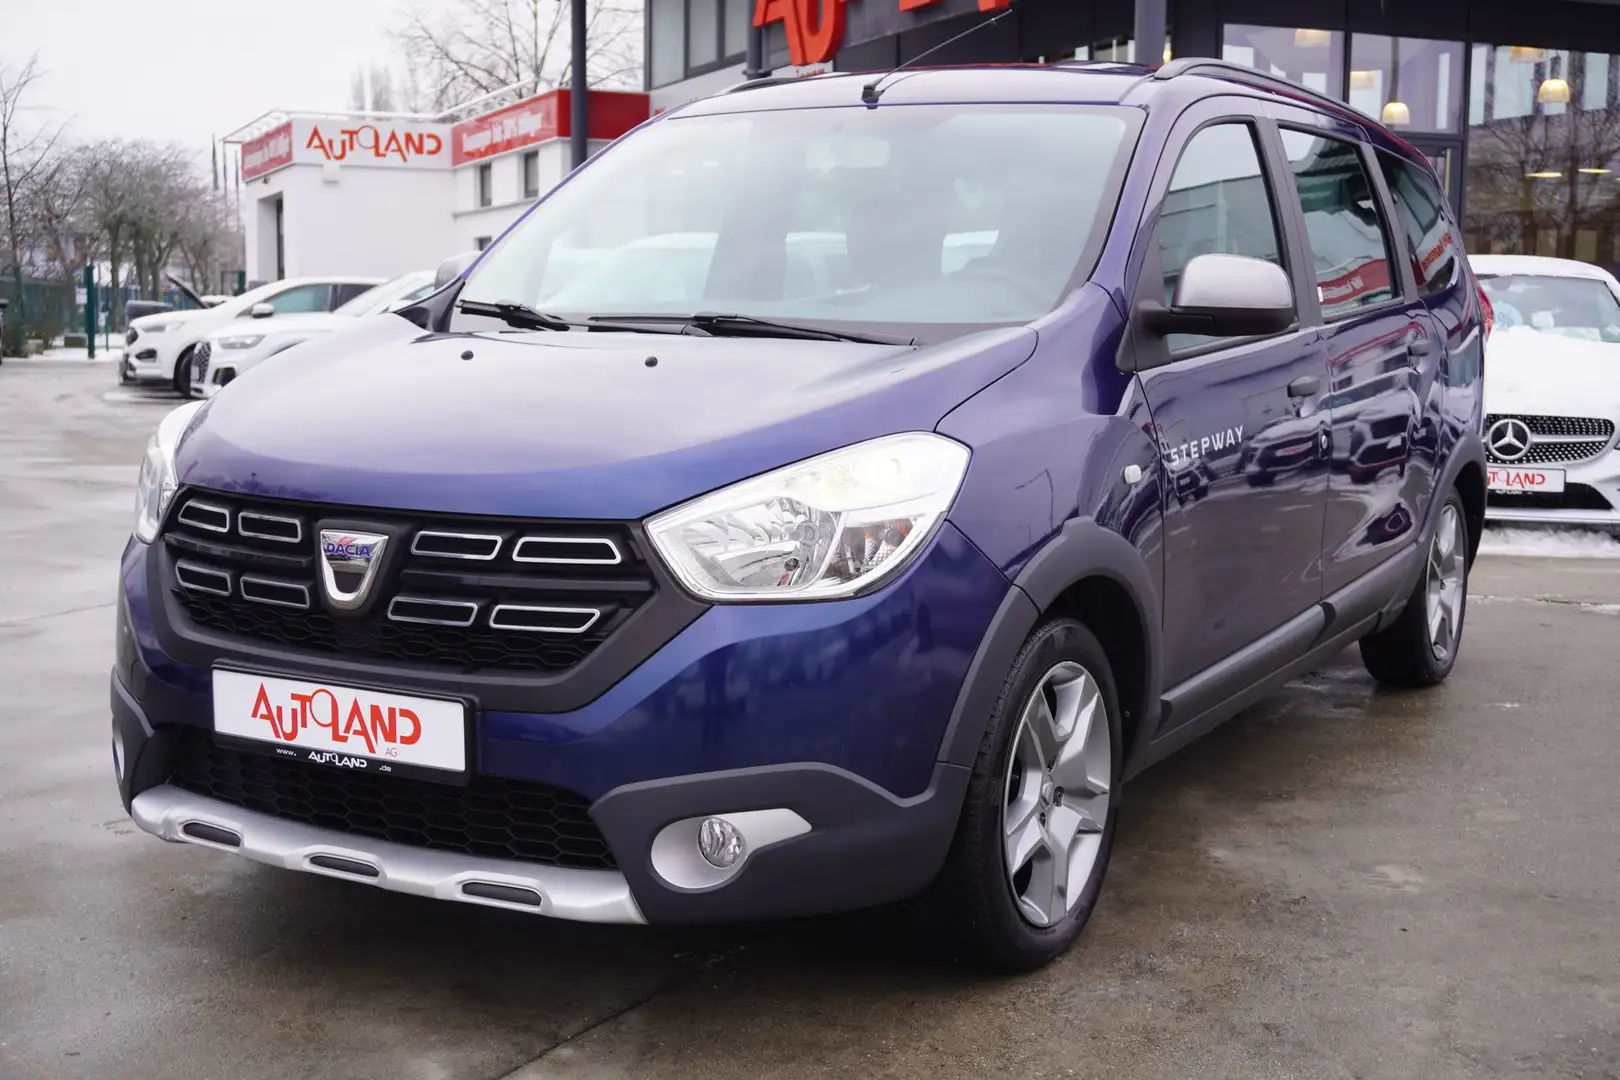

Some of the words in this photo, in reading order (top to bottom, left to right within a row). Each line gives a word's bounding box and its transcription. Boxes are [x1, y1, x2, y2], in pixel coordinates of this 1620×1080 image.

[306, 125, 442, 162] AUTOLAND
[1170, 425, 1244, 466] STEPWAY
[326, 543, 370, 557] DACIA
[251, 682, 421, 754] AUTOLAND
[385, 747, 398, 758] AG
